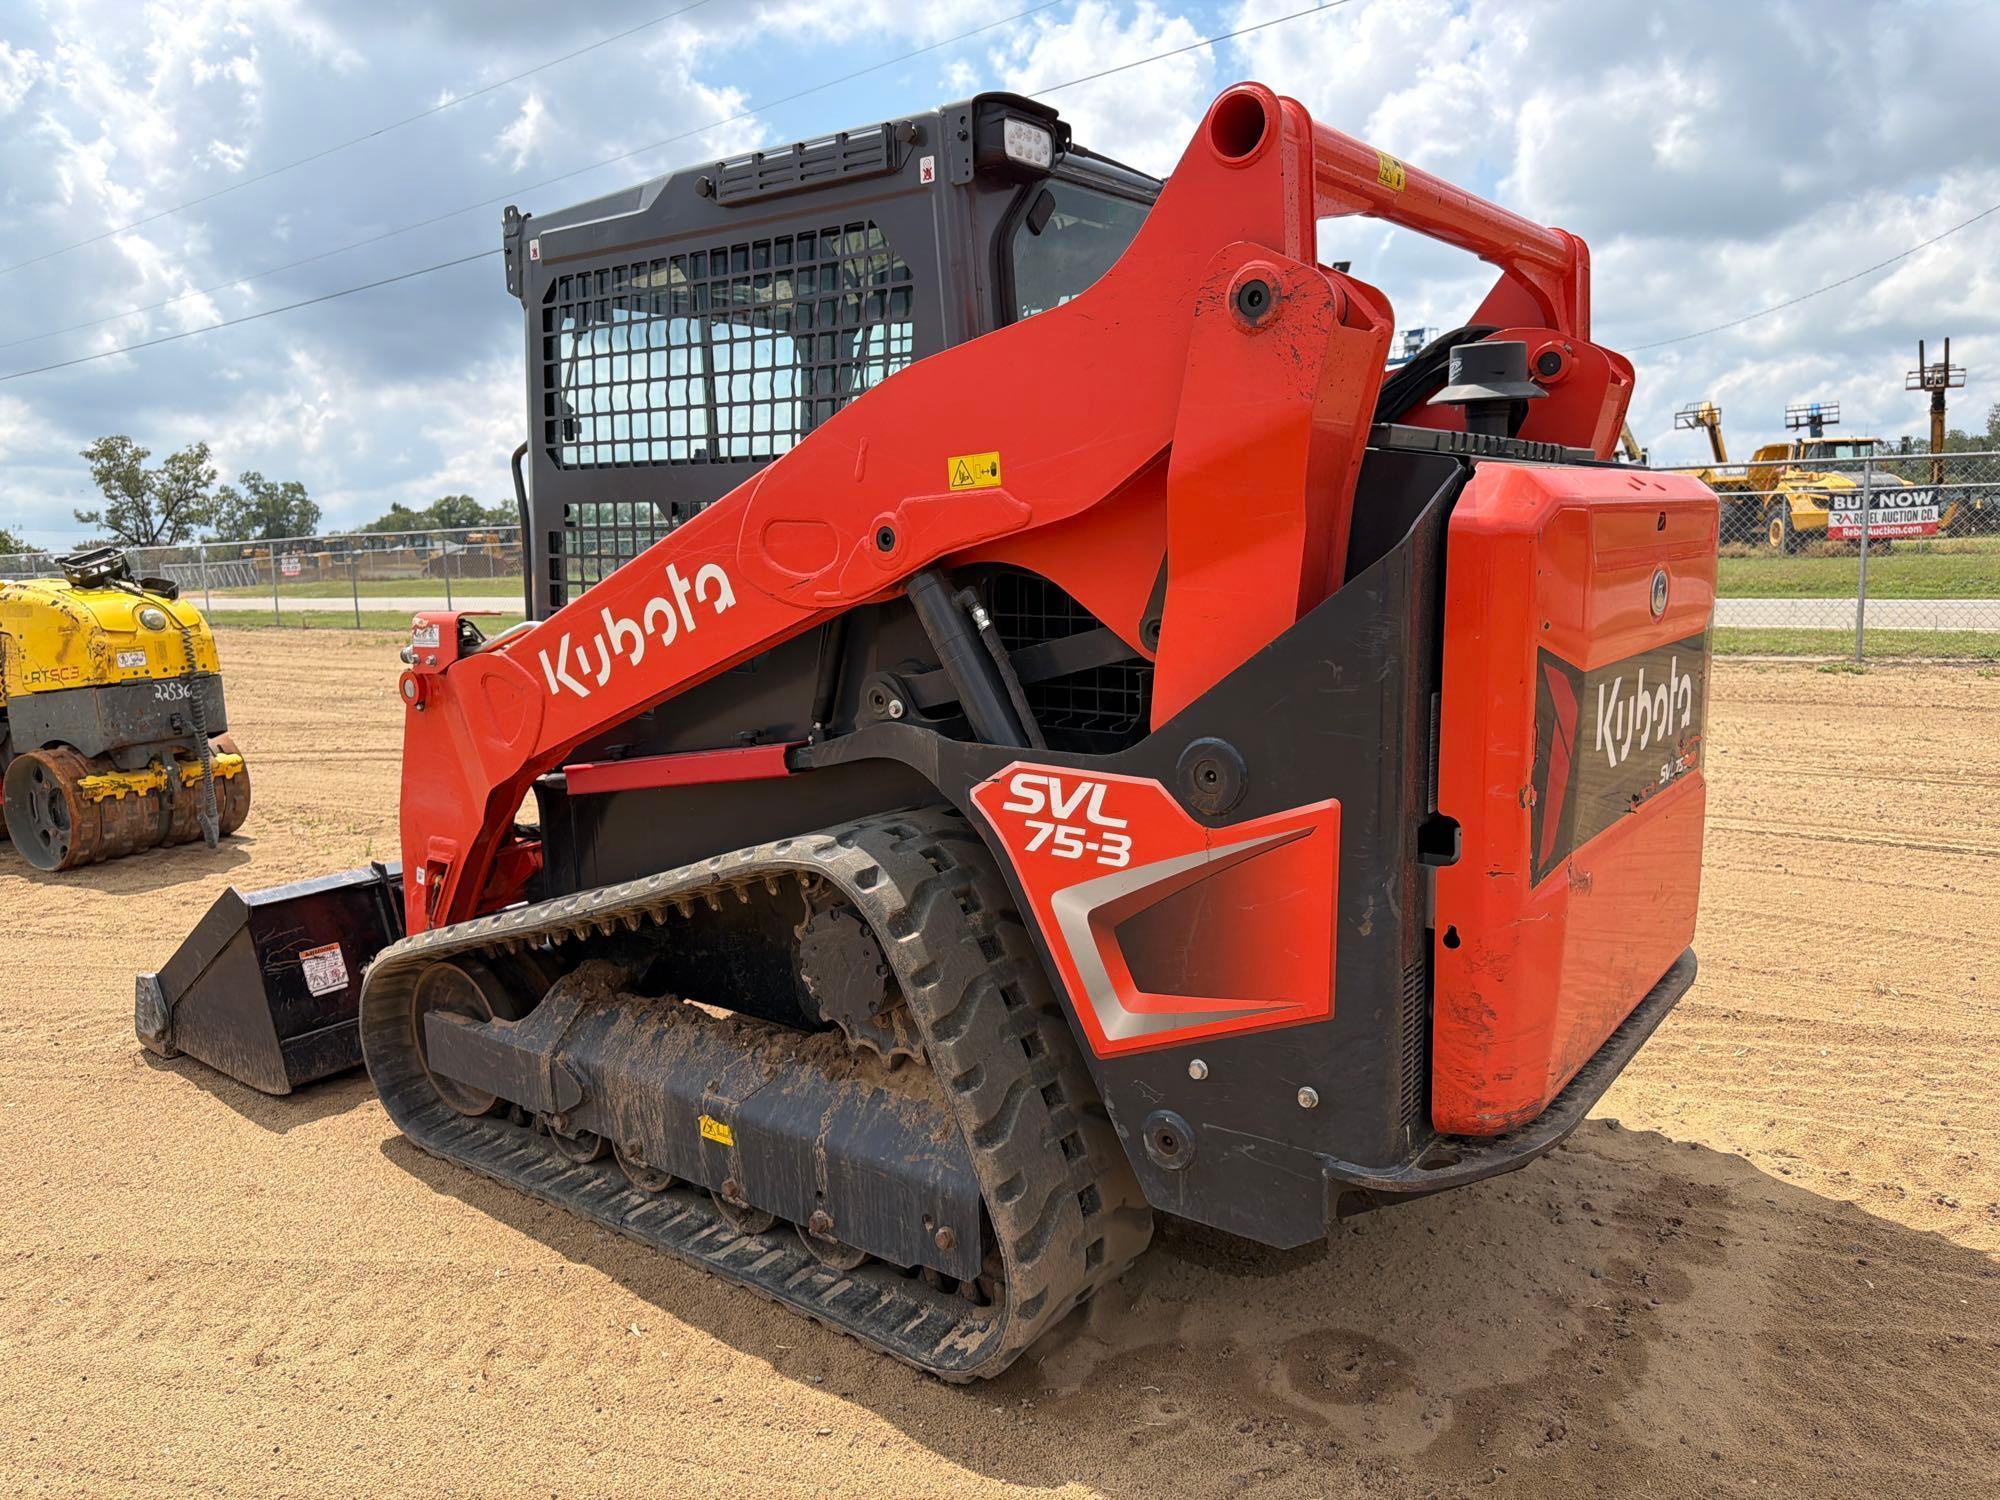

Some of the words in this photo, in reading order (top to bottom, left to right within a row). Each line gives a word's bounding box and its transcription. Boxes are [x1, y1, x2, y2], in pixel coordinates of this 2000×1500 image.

[1880, 491, 1934, 507] NOW
[1881, 510, 1919, 523] AUCTION
[1921, 509, 1935, 521] CO.
[538, 562, 736, 698] Kubota
[1596, 656, 1691, 768] Kubota
[1002, 773, 1128, 828] SVL
[1024, 819, 1132, 867] 75-3
